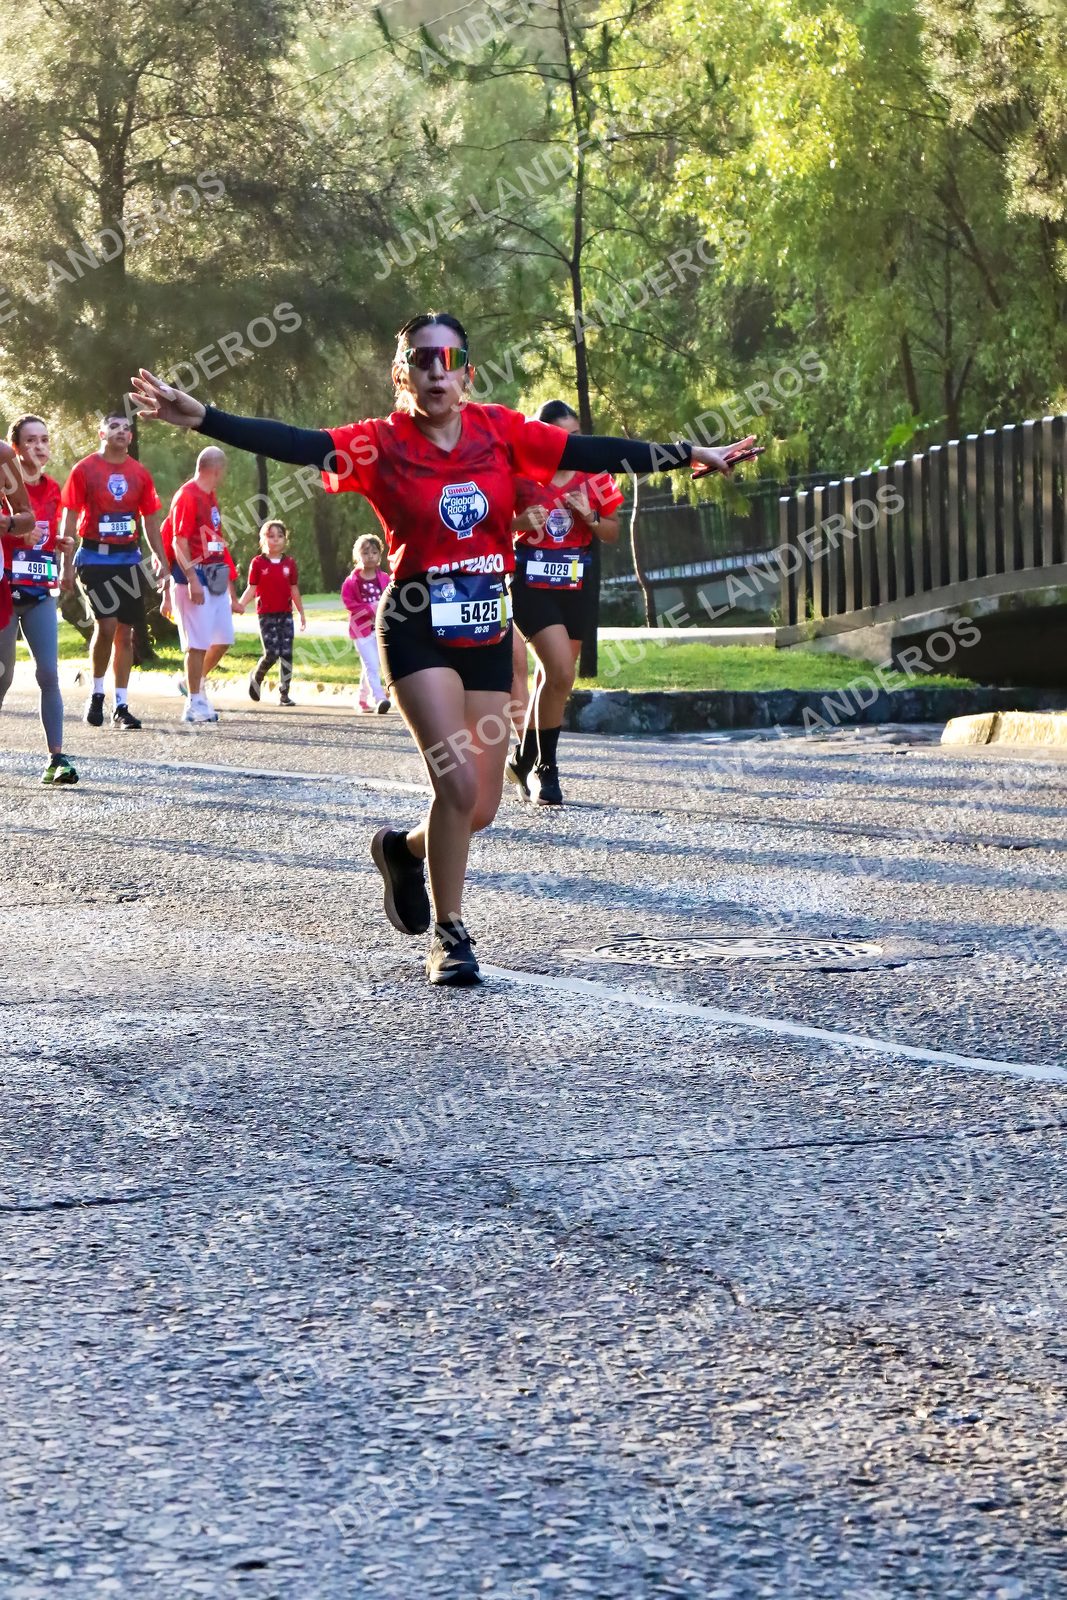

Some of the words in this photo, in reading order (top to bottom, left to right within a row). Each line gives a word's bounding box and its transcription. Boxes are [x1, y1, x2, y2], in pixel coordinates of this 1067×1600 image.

[450, 496, 475, 507] Global
[447, 505, 467, 515] Race
[27, 563, 46, 574] 4981
[543, 563, 569, 576] 4029
[460, 600, 498, 624] 5425
